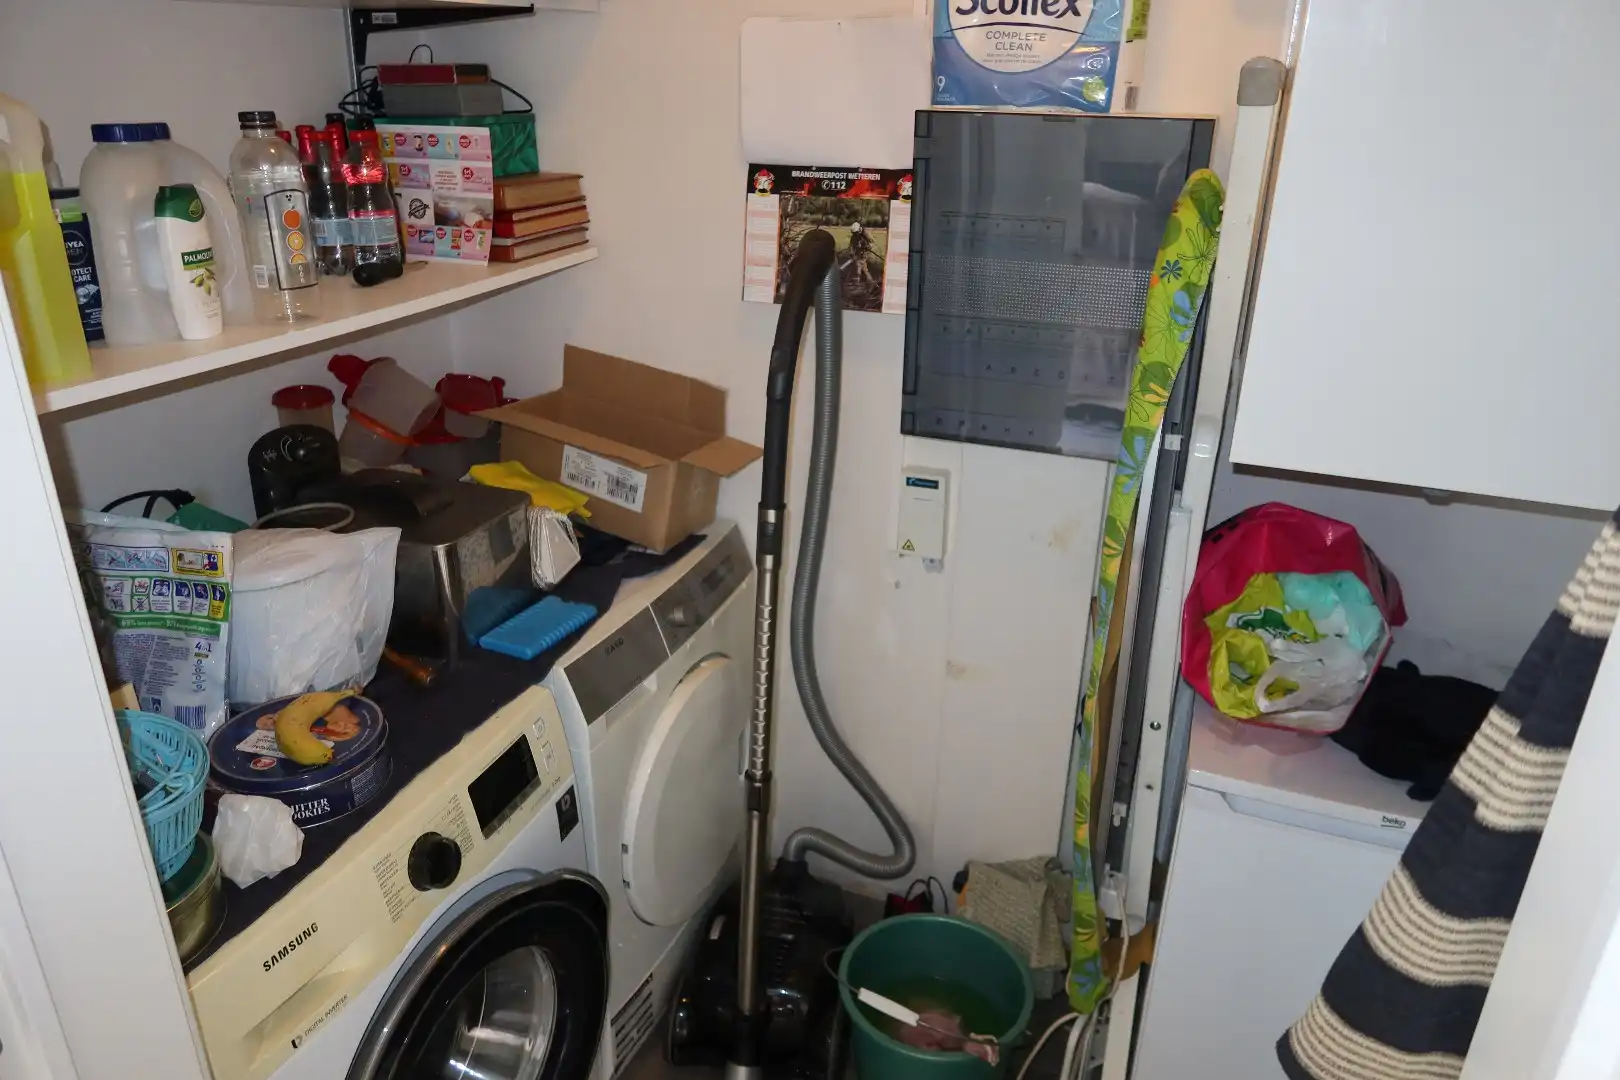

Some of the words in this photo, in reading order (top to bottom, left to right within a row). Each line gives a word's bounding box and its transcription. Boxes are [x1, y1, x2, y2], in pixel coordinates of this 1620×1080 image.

[985, 30, 1047, 42] COMPLETE
[995, 41, 1033, 52] CLEAN
[937, 75, 946, 92] 9
[791, 170, 848, 180] BRANDWEERPOST
[848, 172, 881, 181] WETTEREN
[830, 181, 846, 190] 112
[65, 240, 84, 249] IVEA
[71, 266, 92, 276] OTECT
[73, 274, 92, 283] CARE
[291, 797, 330, 812] UTTER
[293, 805, 330, 820] OKIES
[262, 921, 319, 972] SAMSUNG
